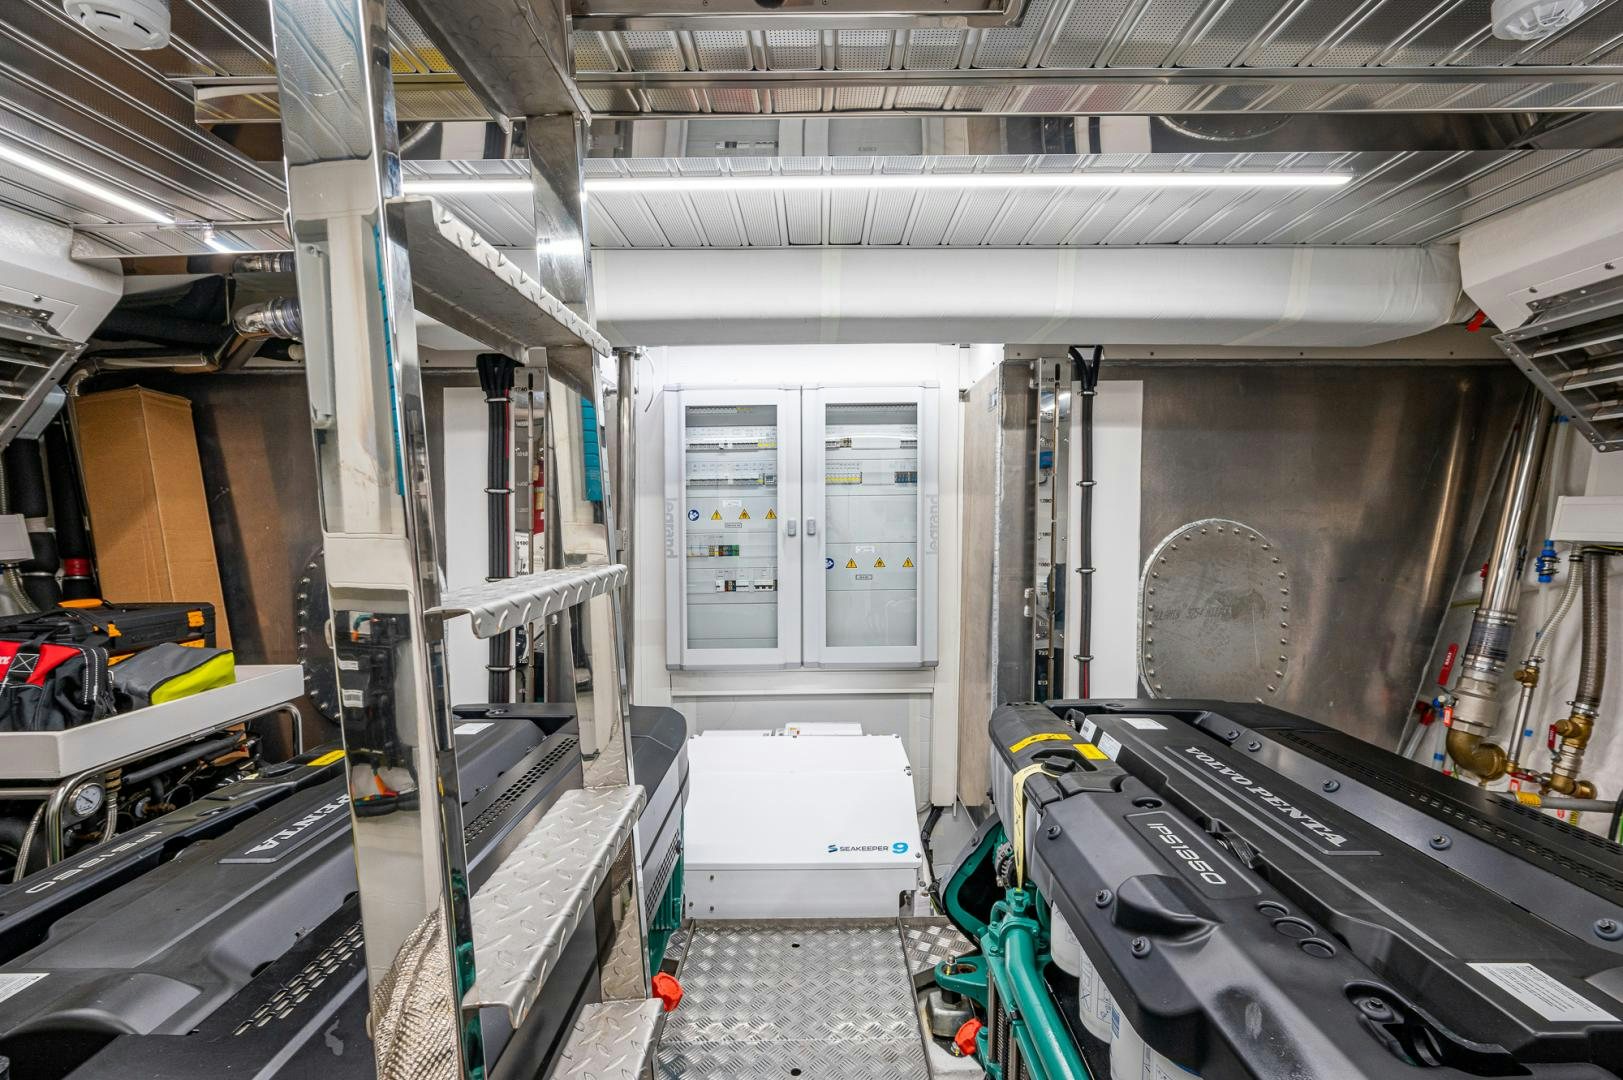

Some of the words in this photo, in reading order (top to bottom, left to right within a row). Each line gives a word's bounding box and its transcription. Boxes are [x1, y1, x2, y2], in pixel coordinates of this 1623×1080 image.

[665, 497, 678, 560] legrand
[926, 494, 938, 555] legrand
[1185, 746, 1253, 789] VOLVO
[1246, 786, 1348, 847] PENTA
[25, 831, 162, 894] IPS1350
[892, 842, 909, 854] 9
[1147, 823, 1227, 884] IPS1350
